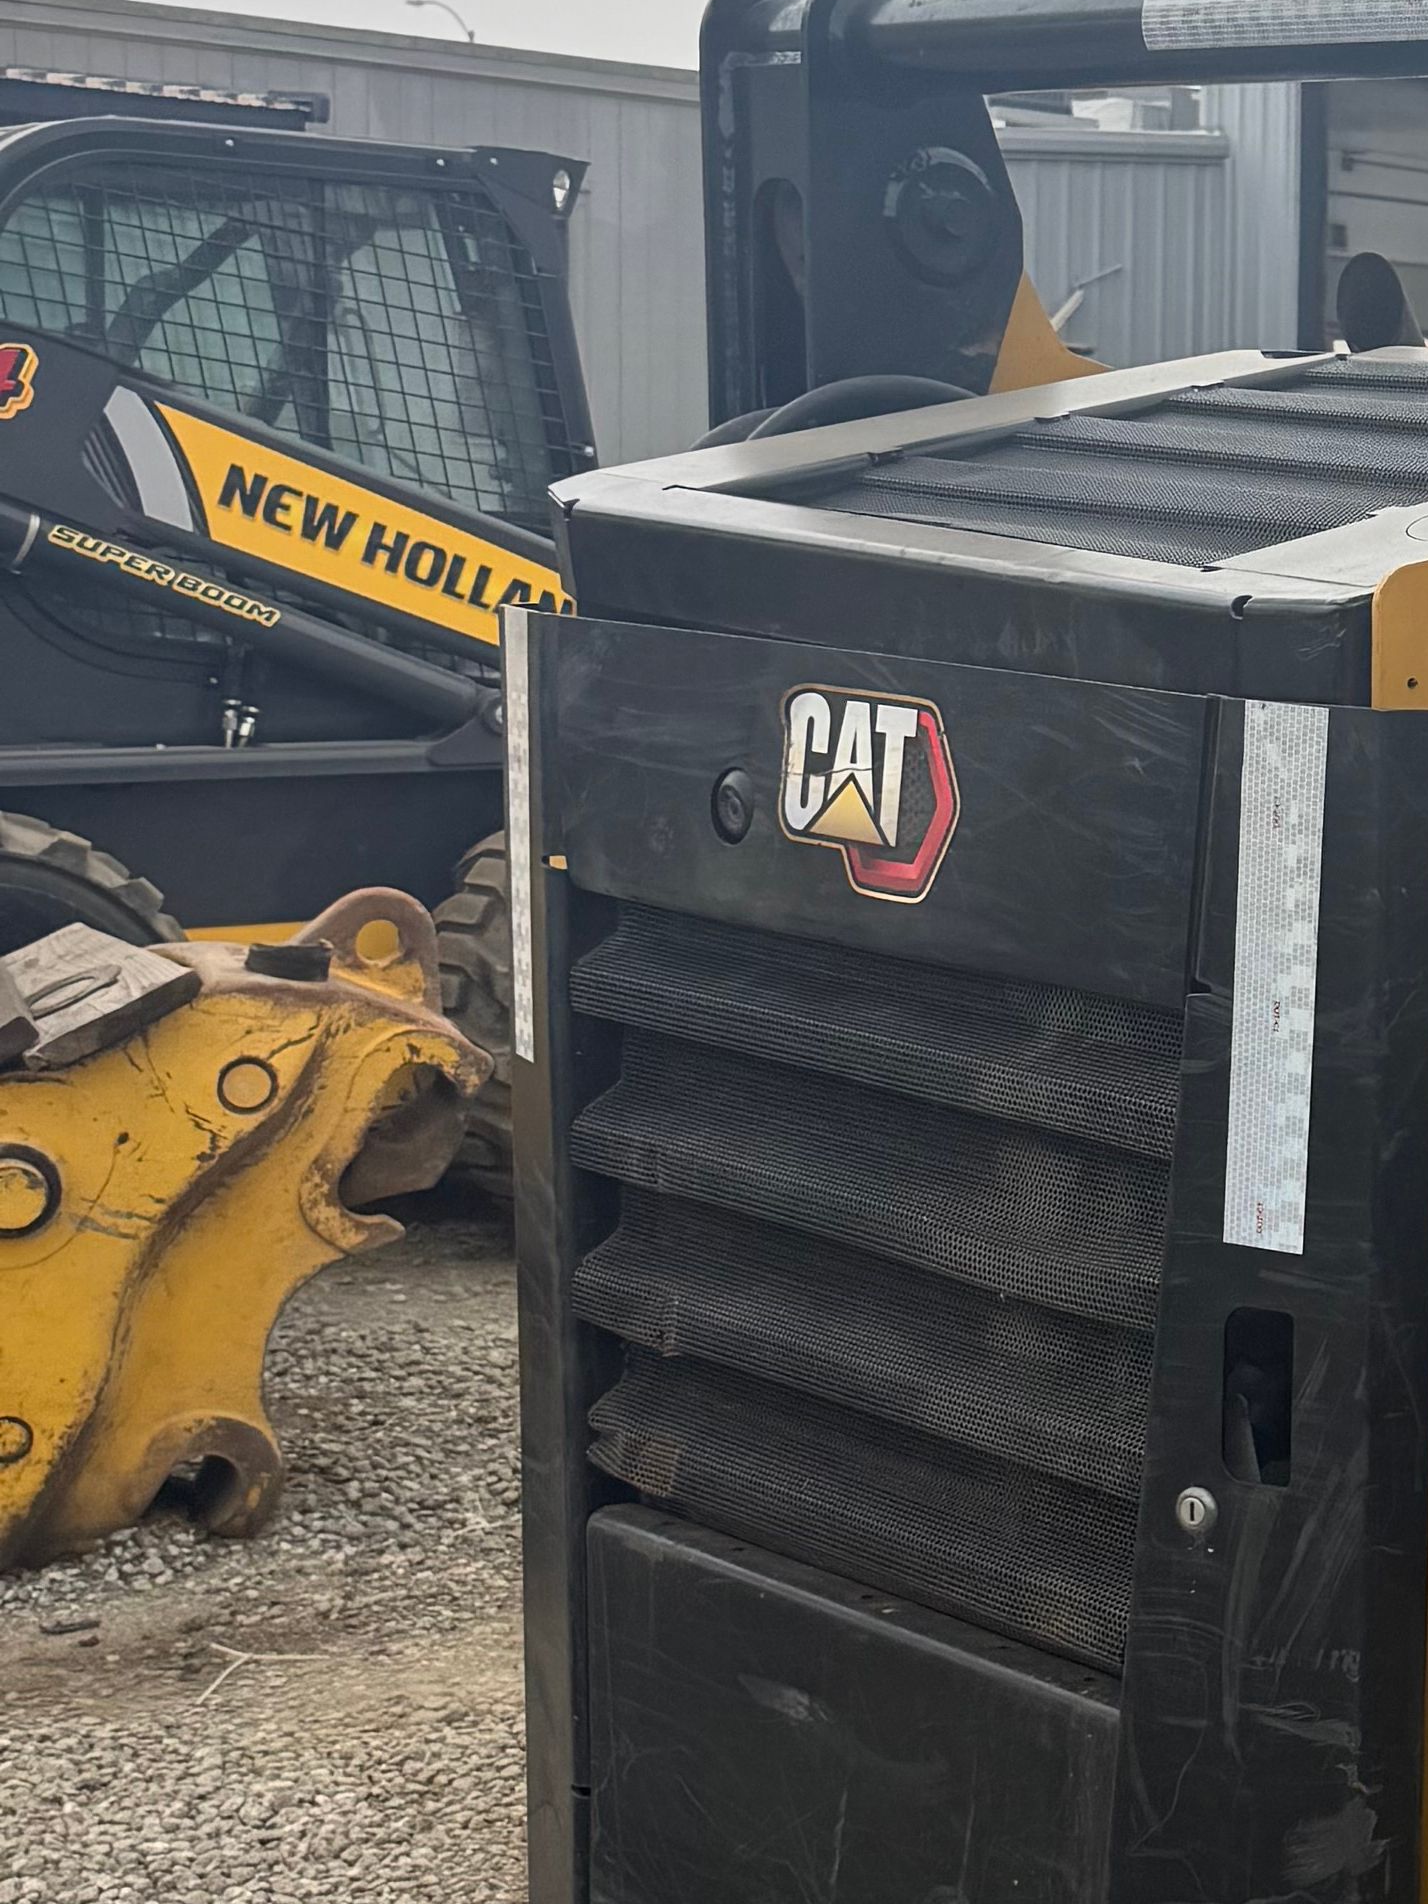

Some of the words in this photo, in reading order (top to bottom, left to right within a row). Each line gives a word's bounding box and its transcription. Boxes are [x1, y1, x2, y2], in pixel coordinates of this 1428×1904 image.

[217, 463, 357, 551] NEW
[53, 526, 171, 582] SUPER
[176, 575, 278, 623] BOOM
[784, 692, 918, 848] CAT
